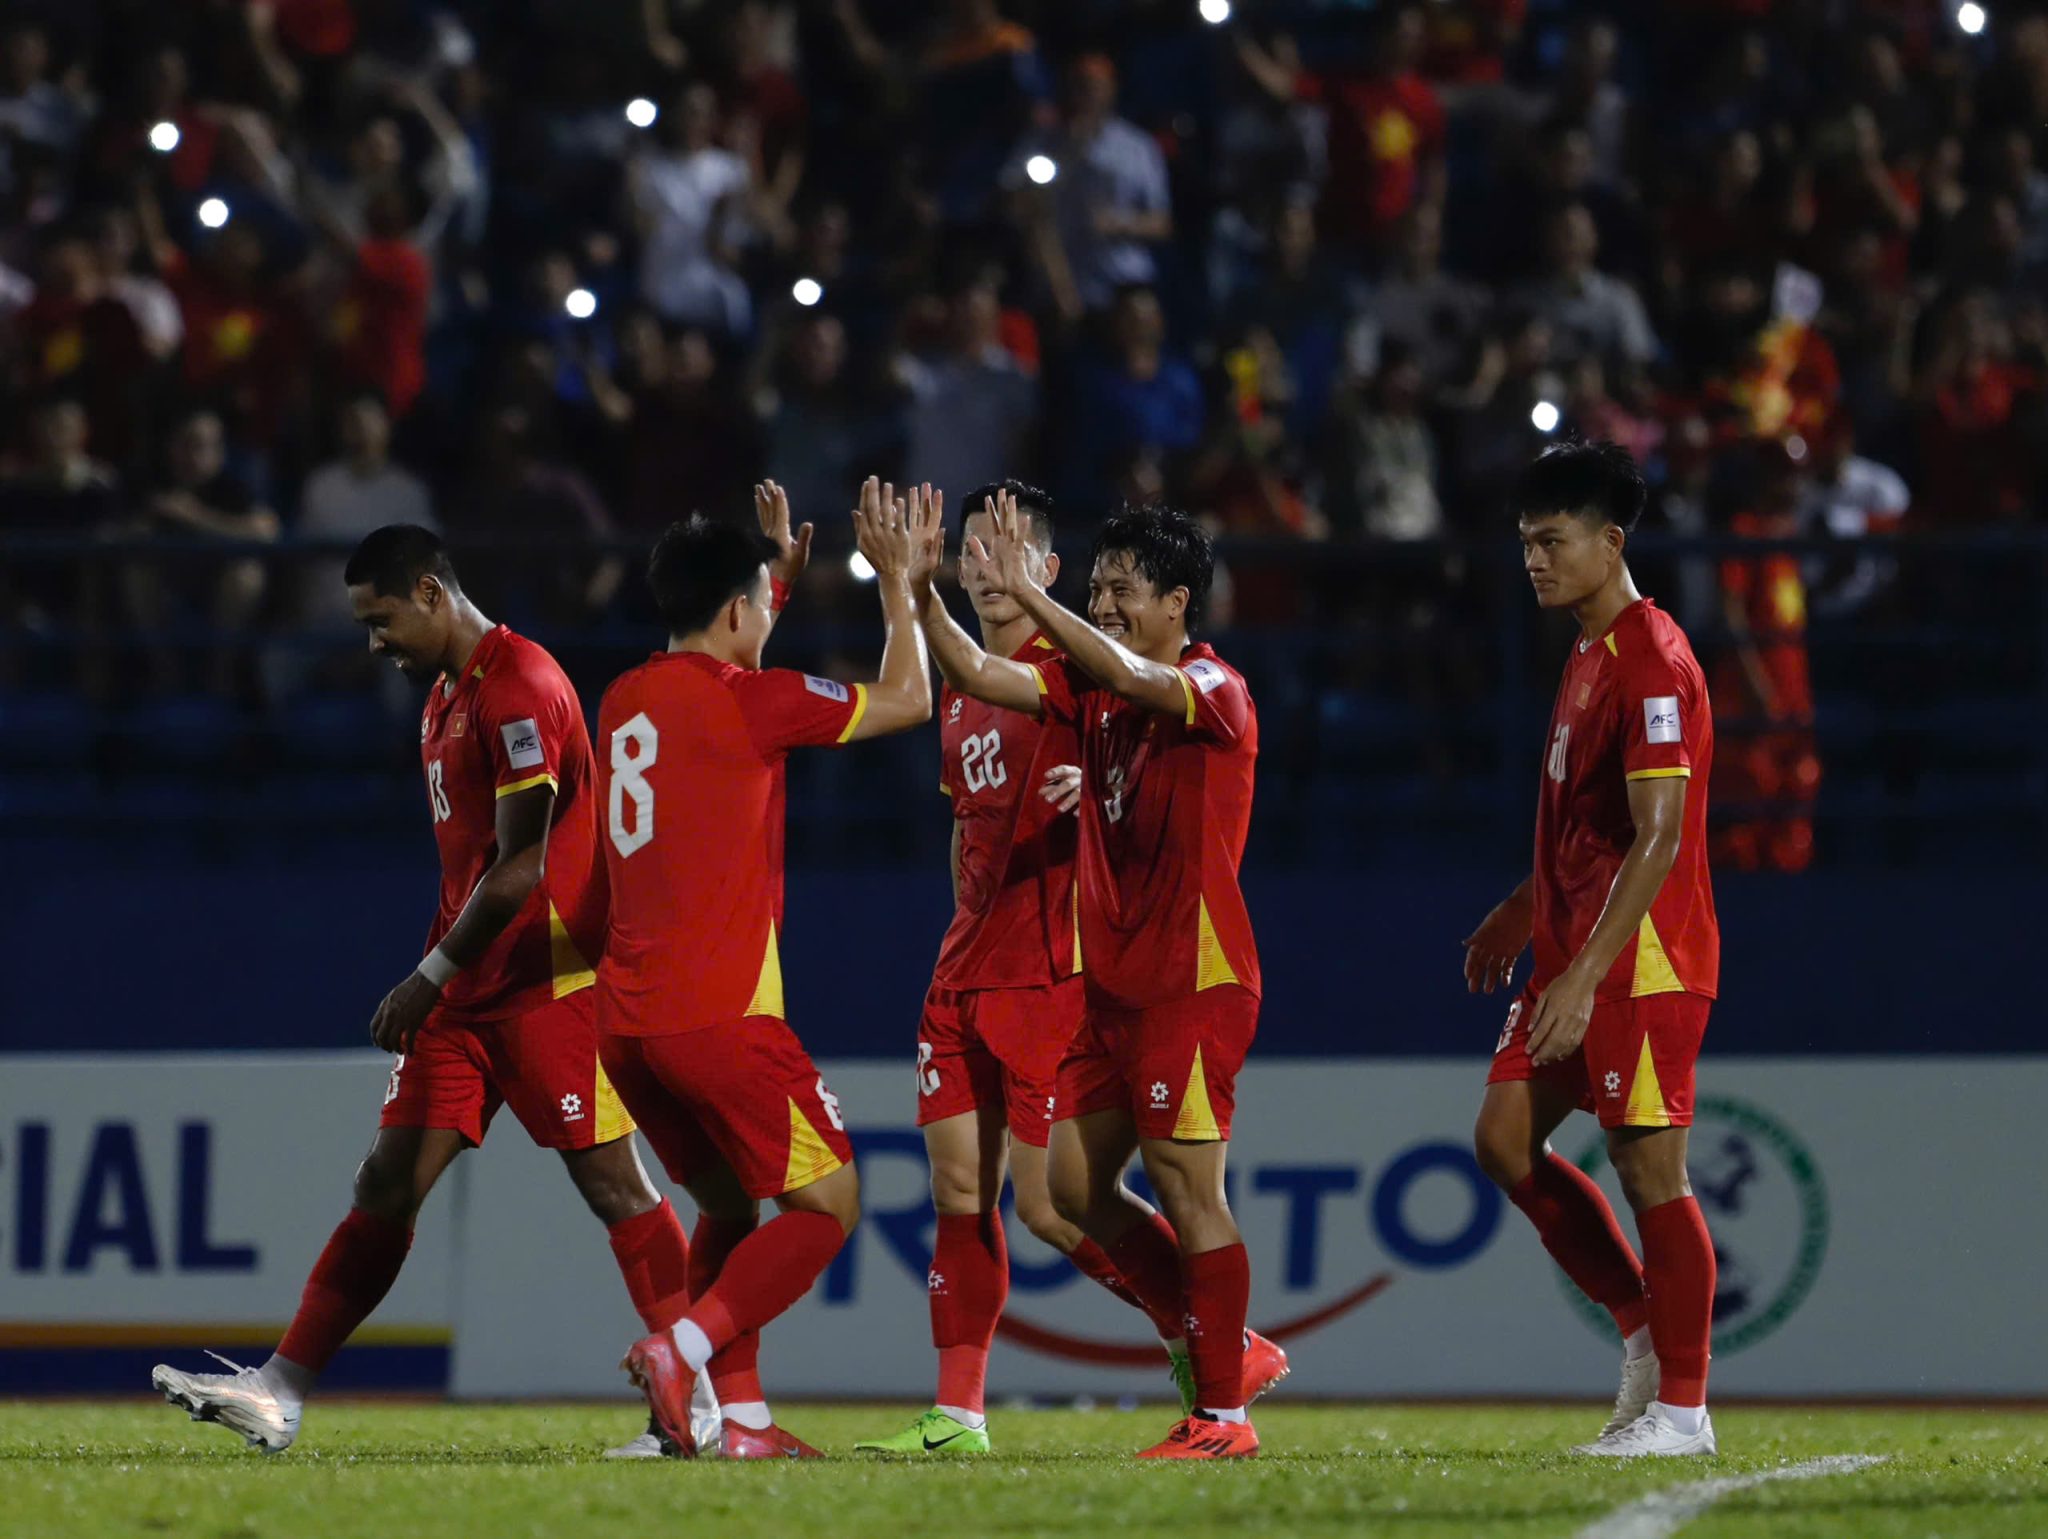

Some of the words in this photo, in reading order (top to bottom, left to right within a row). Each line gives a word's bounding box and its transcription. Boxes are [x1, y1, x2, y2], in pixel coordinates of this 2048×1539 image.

[511, 735, 536, 752] AFC
[1649, 712, 1676, 727] AFC
[428, 759, 451, 824] 13
[609, 711, 658, 859] 8
[961, 728, 1007, 793] 22
[916, 1042, 941, 1096] 2
[0, 1121, 258, 1273] IAL
